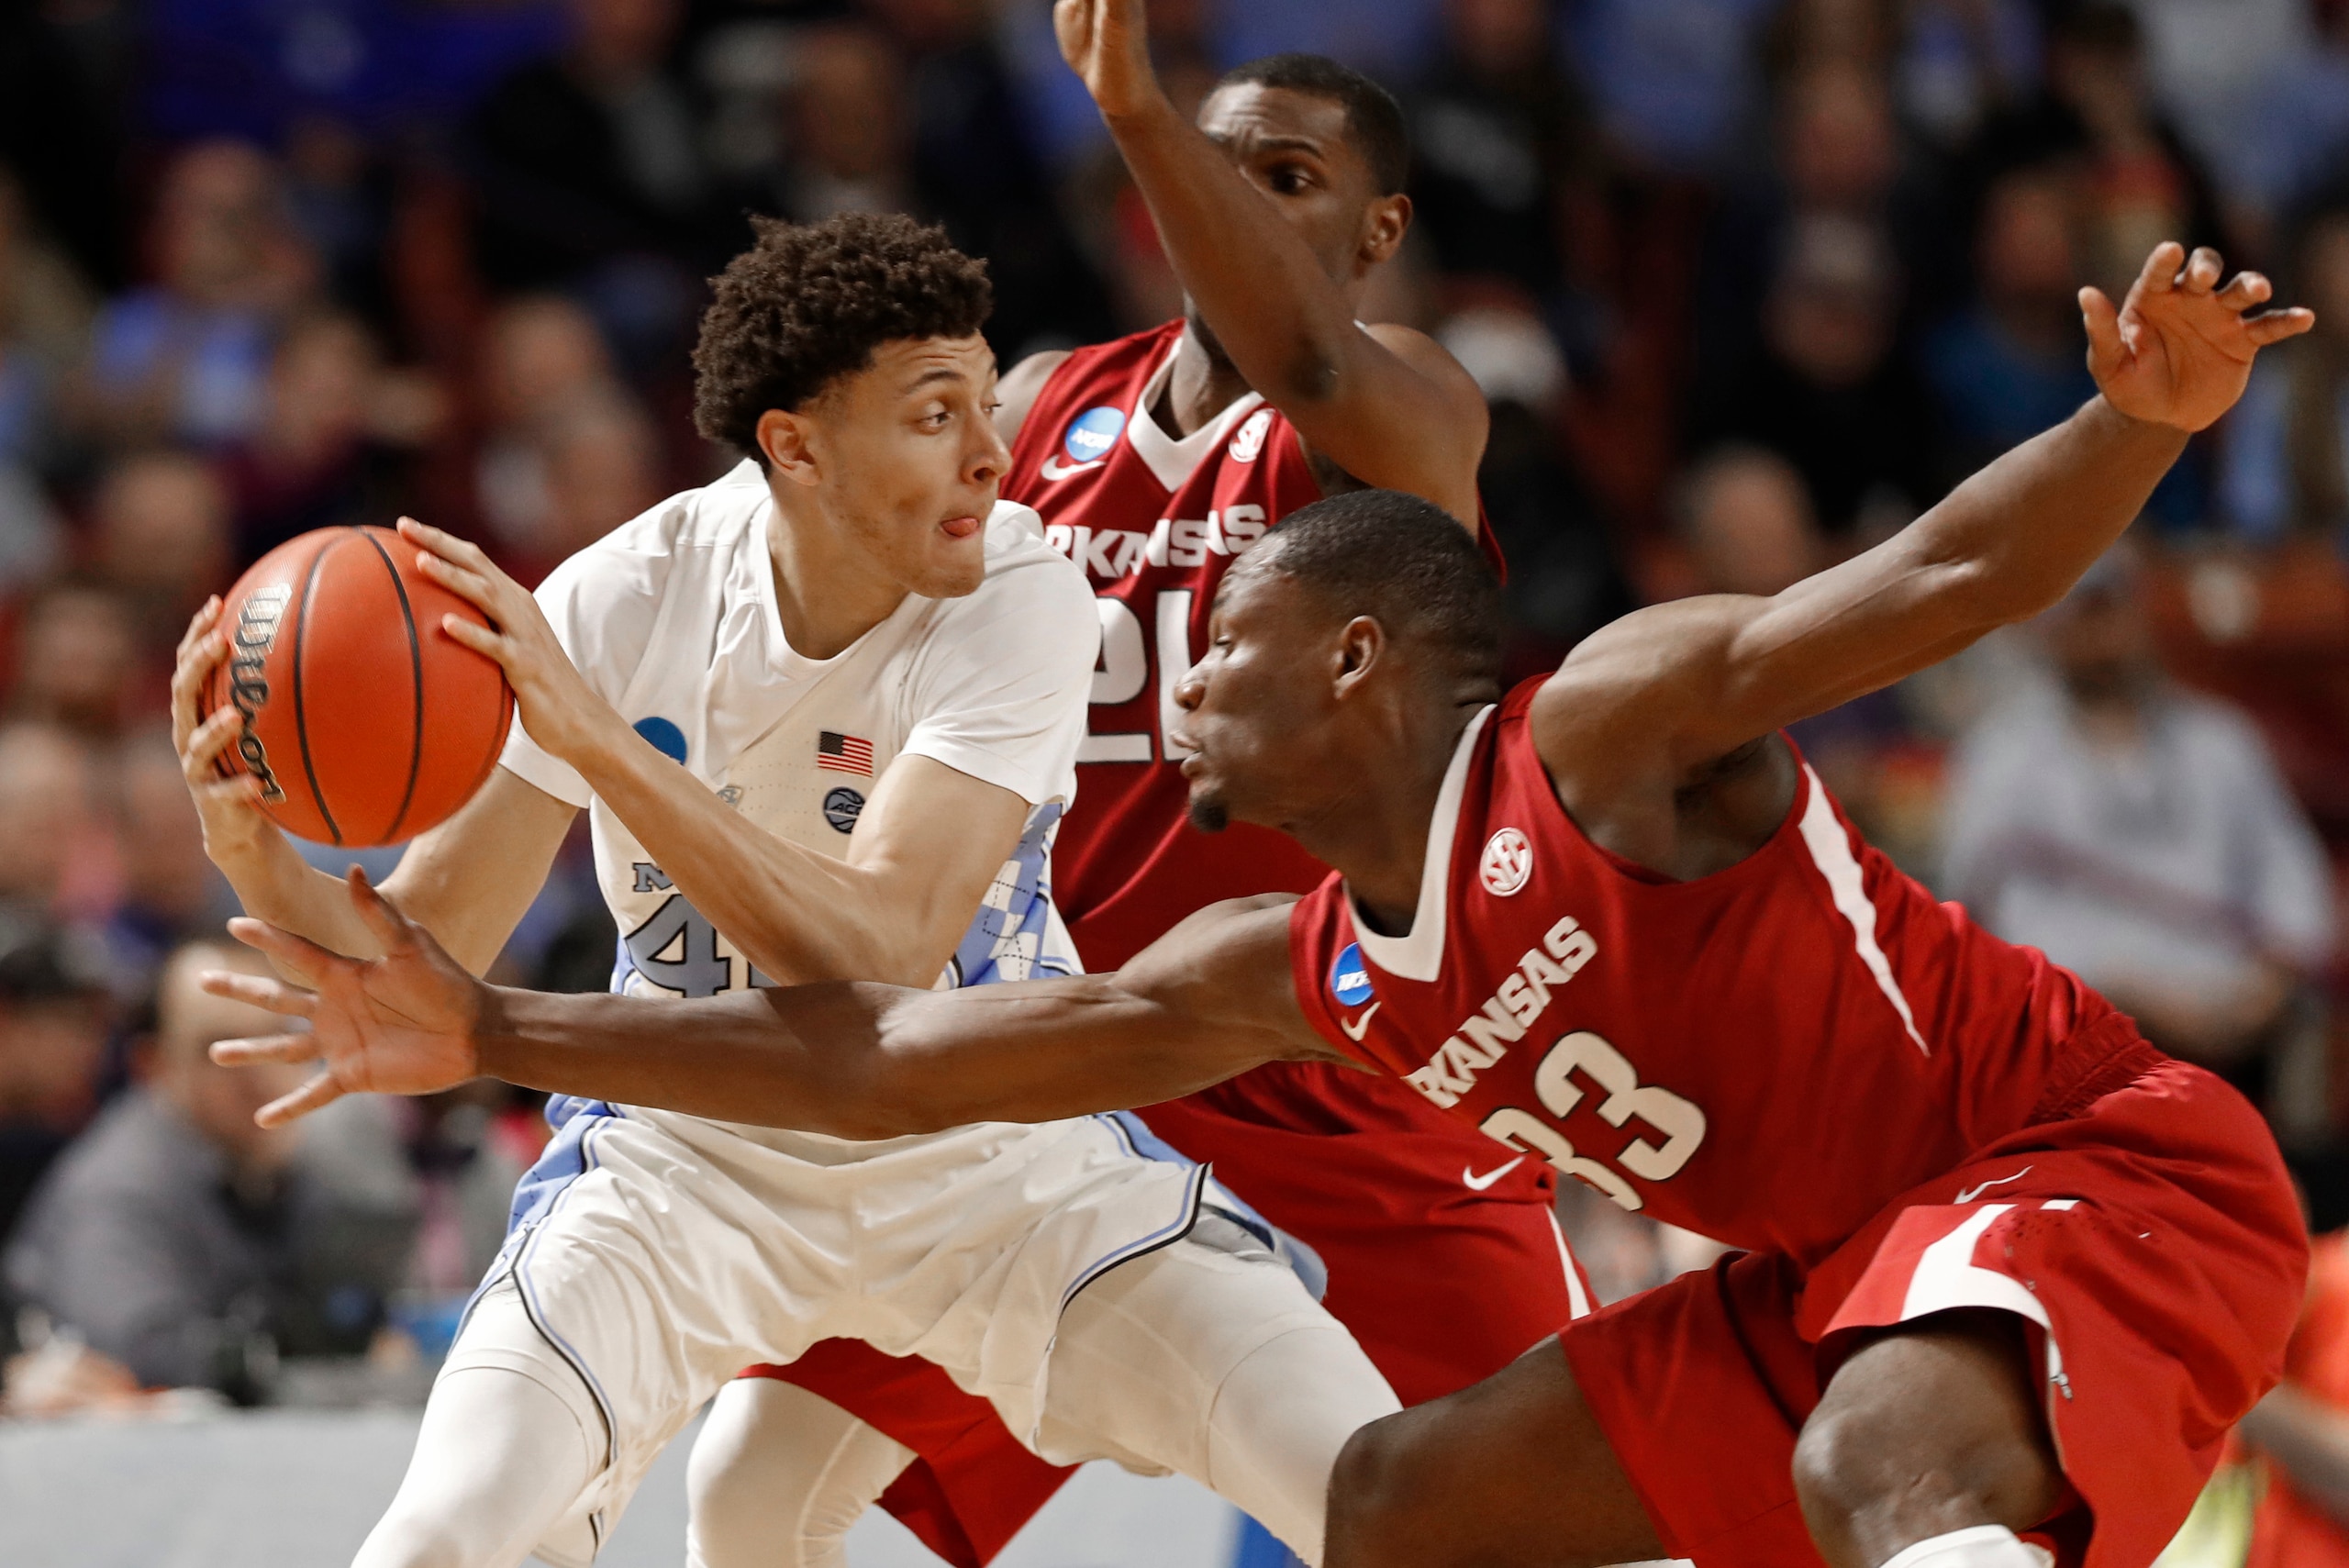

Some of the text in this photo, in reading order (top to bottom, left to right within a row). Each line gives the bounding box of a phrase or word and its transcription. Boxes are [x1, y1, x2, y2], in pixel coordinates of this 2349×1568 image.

[1044, 504, 1266, 578] RKANSAS
[624, 894, 782, 999] 4
[1401, 916, 1598, 1109] RKANSAS
